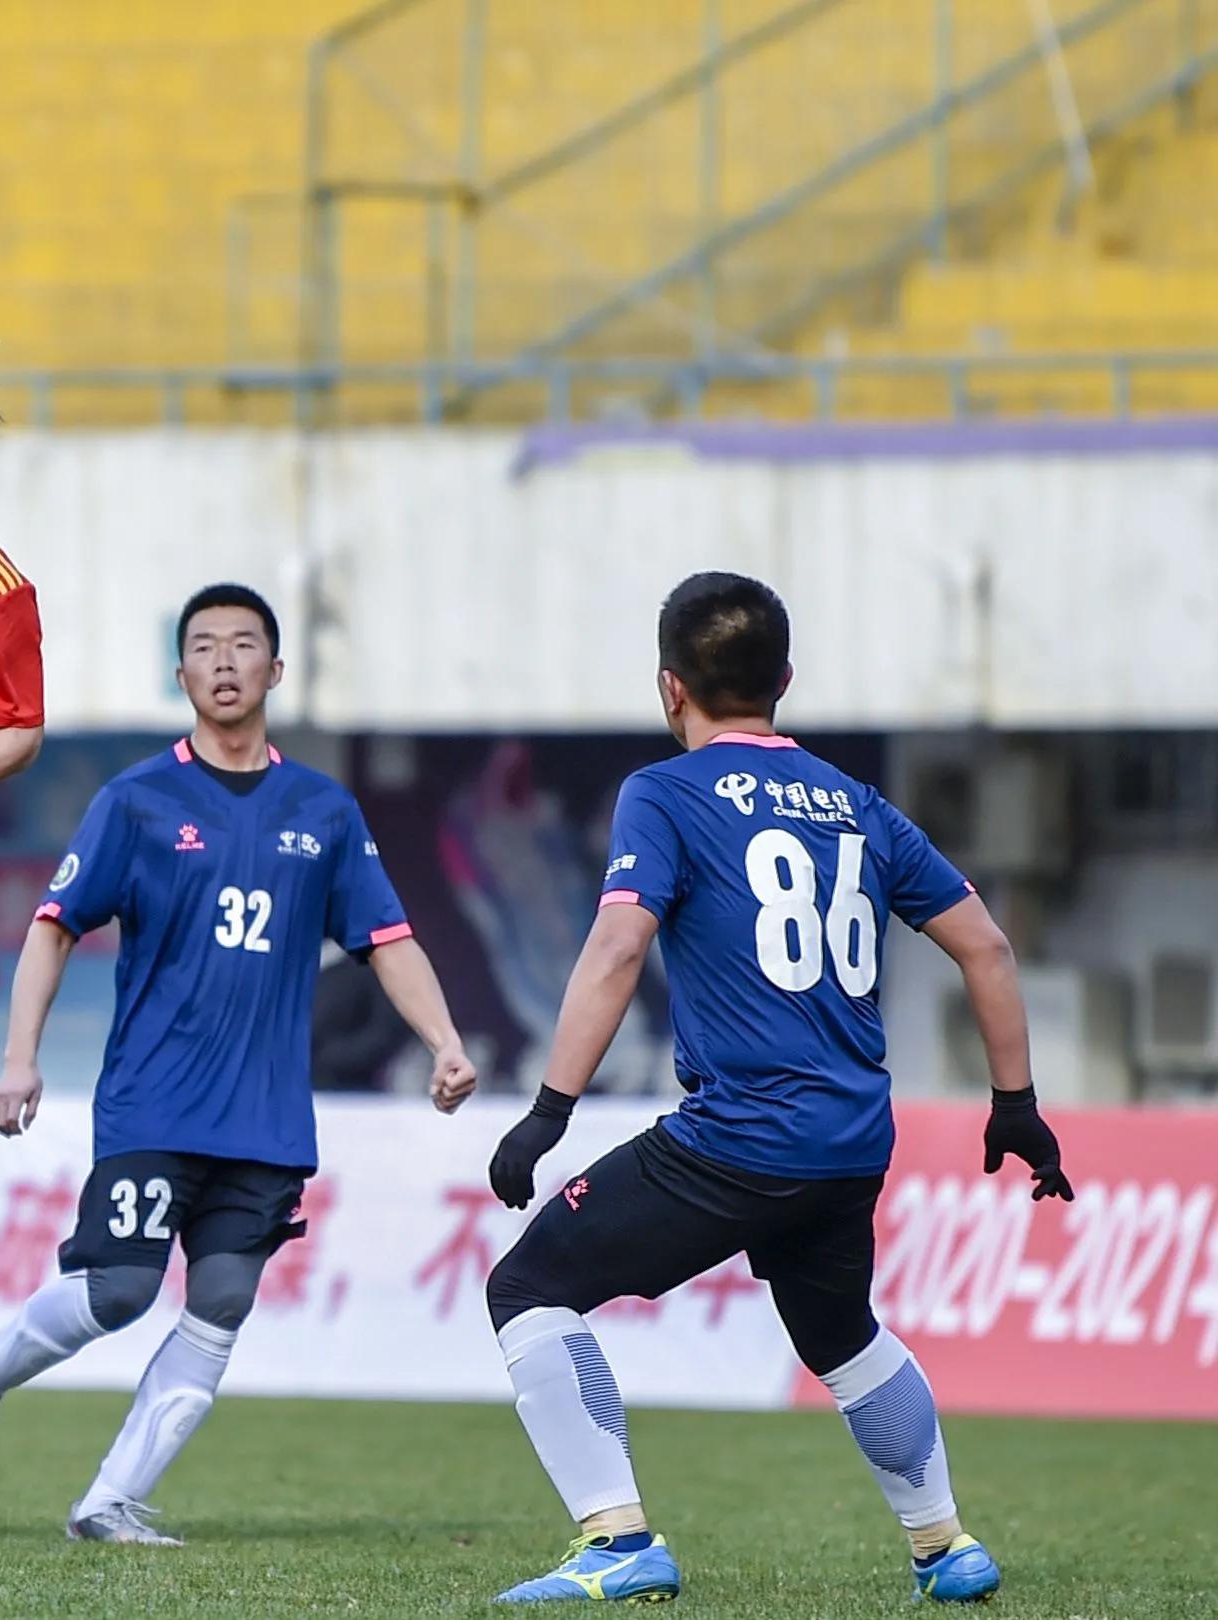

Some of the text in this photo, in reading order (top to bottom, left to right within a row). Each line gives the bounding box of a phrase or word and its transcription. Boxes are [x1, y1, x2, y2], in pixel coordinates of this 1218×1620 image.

[764, 778, 853, 815] 中国电信
[214, 885, 273, 953] 32
[745, 828, 877, 998] 86
[108, 1178, 172, 1240] 32
[874, 1176, 1218, 1366] 2020-2021
